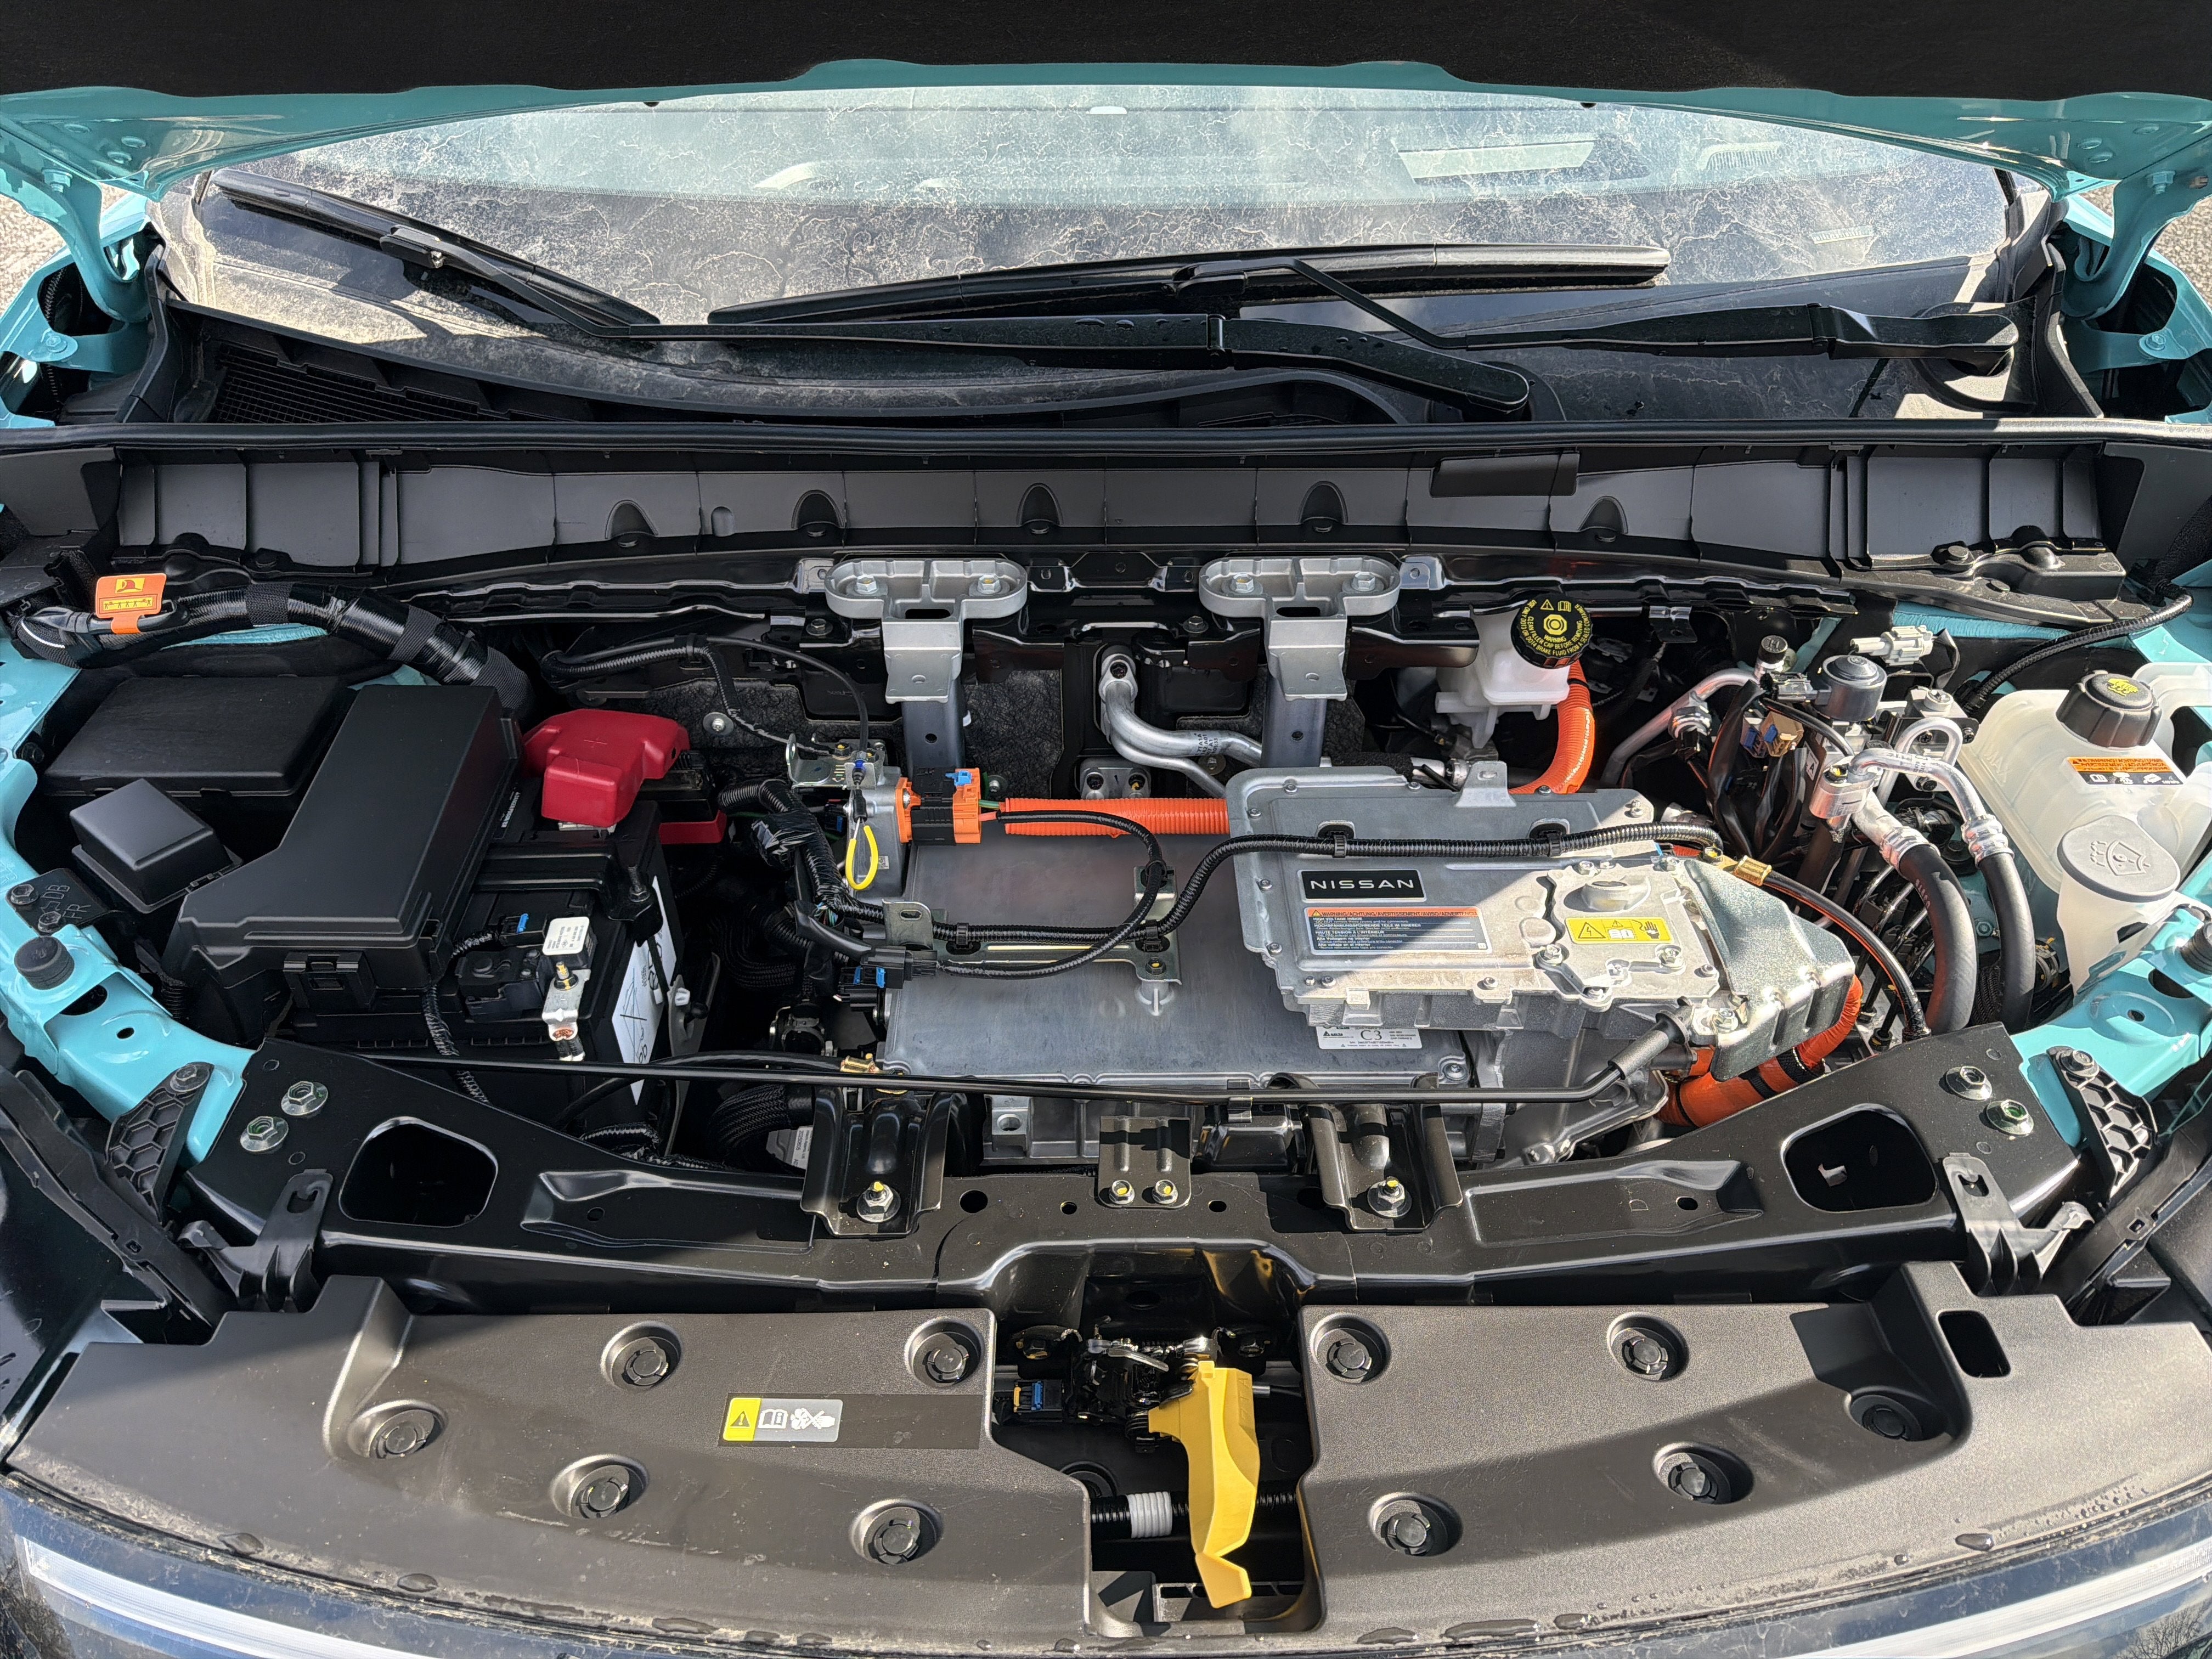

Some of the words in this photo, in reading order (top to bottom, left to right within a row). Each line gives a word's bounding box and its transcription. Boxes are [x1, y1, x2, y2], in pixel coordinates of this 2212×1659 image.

[1527, 599, 1537, 609] USE
[1574, 603, 1590, 627] CONTAINER
[1530, 629, 1544, 645] FILLER
[1554, 640, 1574, 650] BEFORE
[1572, 620, 1583, 642] REMOVING
[1544, 634, 1567, 644] WARNING
[1582, 627, 1590, 644] SEALED
[1525, 635, 1537, 647] DOT4
[1536, 645, 1552, 656] BRAKE
[1567, 644, 1580, 654] FROM
[1809, 763, 1815, 774] A
[1310, 879, 1414, 889] NISSAN
[40, 885, 70, 900] DB
[61, 904, 91, 919] FR
[1360, 1030, 1383, 1040] C3
